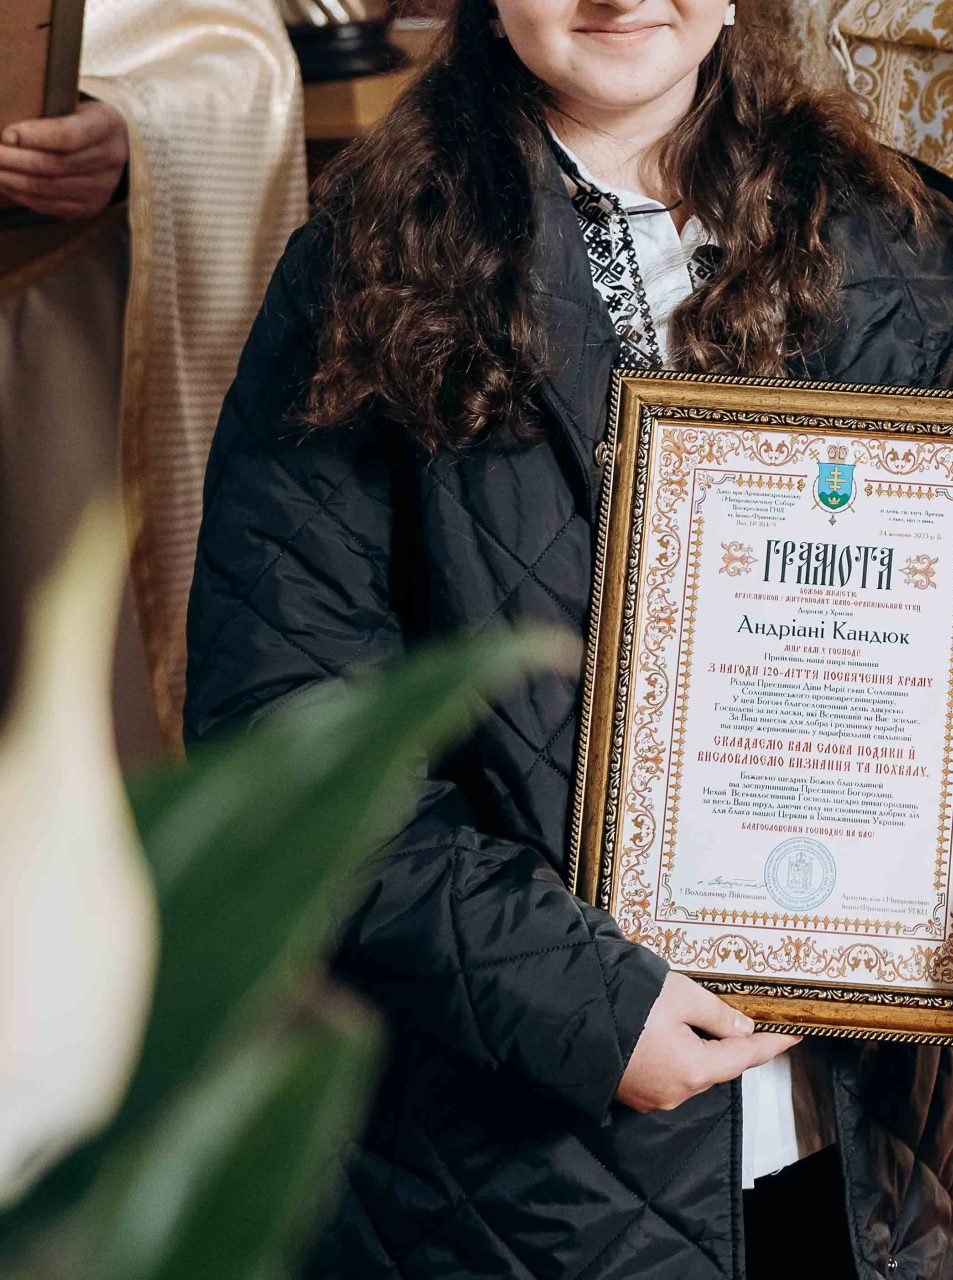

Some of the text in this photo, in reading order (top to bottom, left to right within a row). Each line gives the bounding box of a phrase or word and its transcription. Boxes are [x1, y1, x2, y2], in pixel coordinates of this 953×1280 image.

[762, 539, 895, 591] ГРАМОТА
[736, 614, 910, 645] Андріані Кандюк
[707, 662, 934, 688] З НАГОДИ 120-ЛІТТЯ ПОСВЯЧЕННЯ ХРАМУ
[713, 735, 916, 761] СКЛАДАЄМО ВАМ СЛОВА ПОДЯКИ Й
[697, 750, 930, 778] ВИСЛОВЛЮЄМО ВИЗНАННЯ ТА ПОХВАЛУ.
